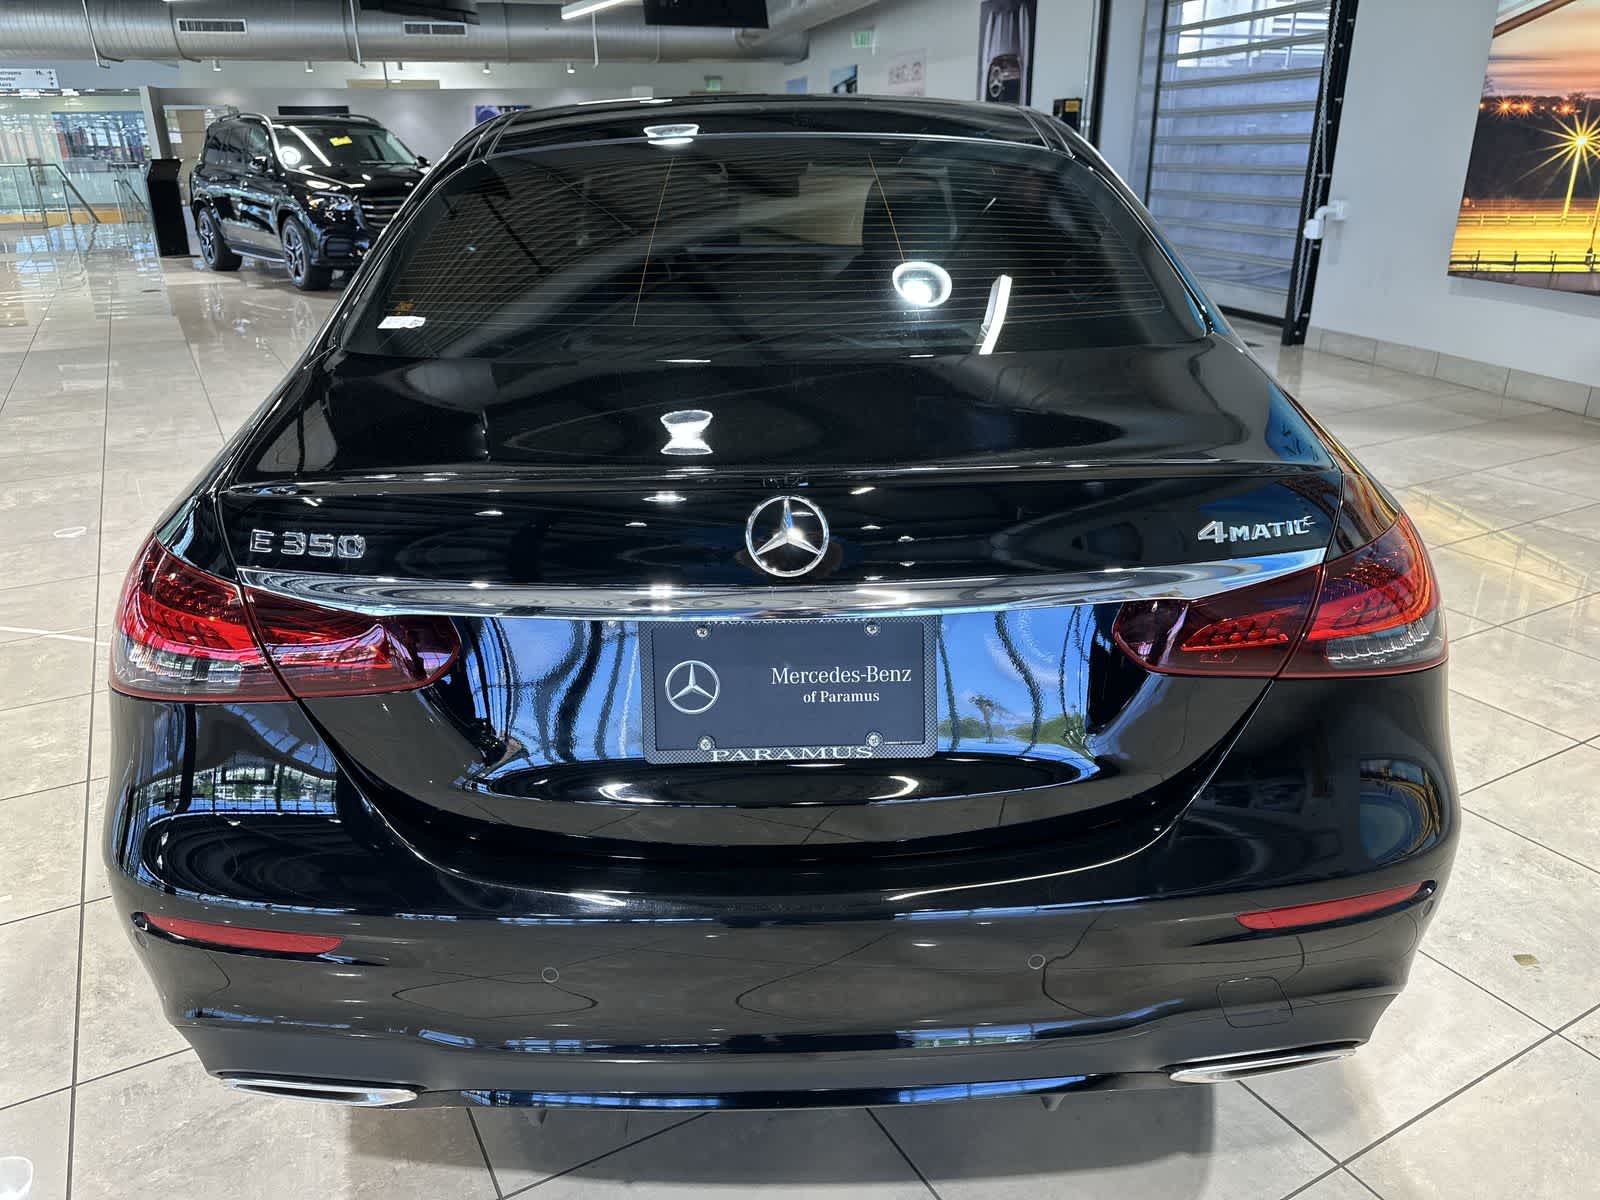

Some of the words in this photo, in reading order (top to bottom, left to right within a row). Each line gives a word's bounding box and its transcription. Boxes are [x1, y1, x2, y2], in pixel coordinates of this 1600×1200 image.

[249, 528, 275, 553] E
[280, 531, 366, 559] 350
[771, 665, 912, 685] Mercedes-Benz
[803, 690, 818, 704] of
[820, 690, 880, 704] Paramus
[710, 746, 874, 763] PARAMUS
